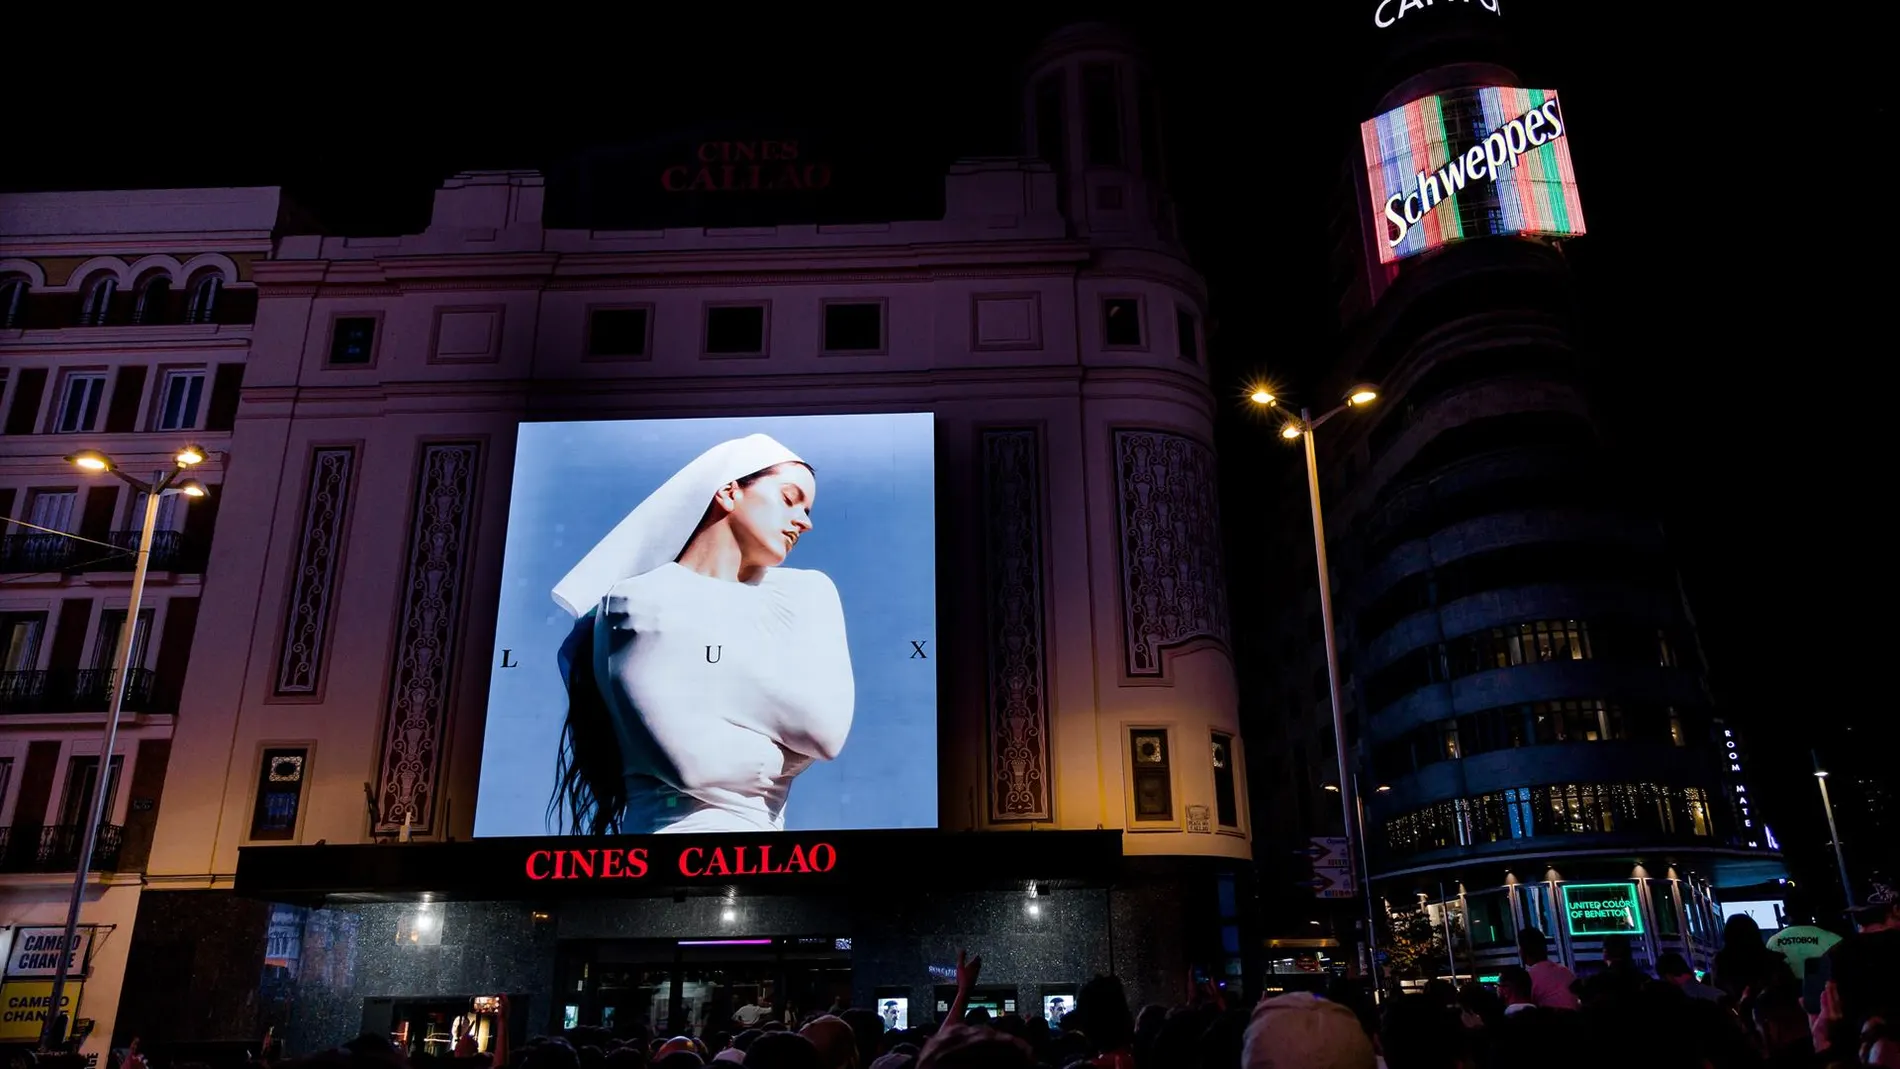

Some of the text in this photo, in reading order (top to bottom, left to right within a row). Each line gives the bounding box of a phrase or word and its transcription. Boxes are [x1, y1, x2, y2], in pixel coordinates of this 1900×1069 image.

[697, 140, 800, 163] CINES
[660, 162, 832, 192] CALLAO
[1384, 99, 1564, 248] Schweppes
[501, 641, 927, 667] L U X
[1724, 729, 1752, 828] ROOM MATE
[525, 842, 837, 880] CINES CALLAO
[1569, 900, 1635, 910] UNITED COLORS
[1571, 909, 1628, 919] OF BENETTON
[24, 935, 81, 951] CAMBO
[19, 953, 76, 969] CHANE
[9, 996, 69, 1008] CAMBO
